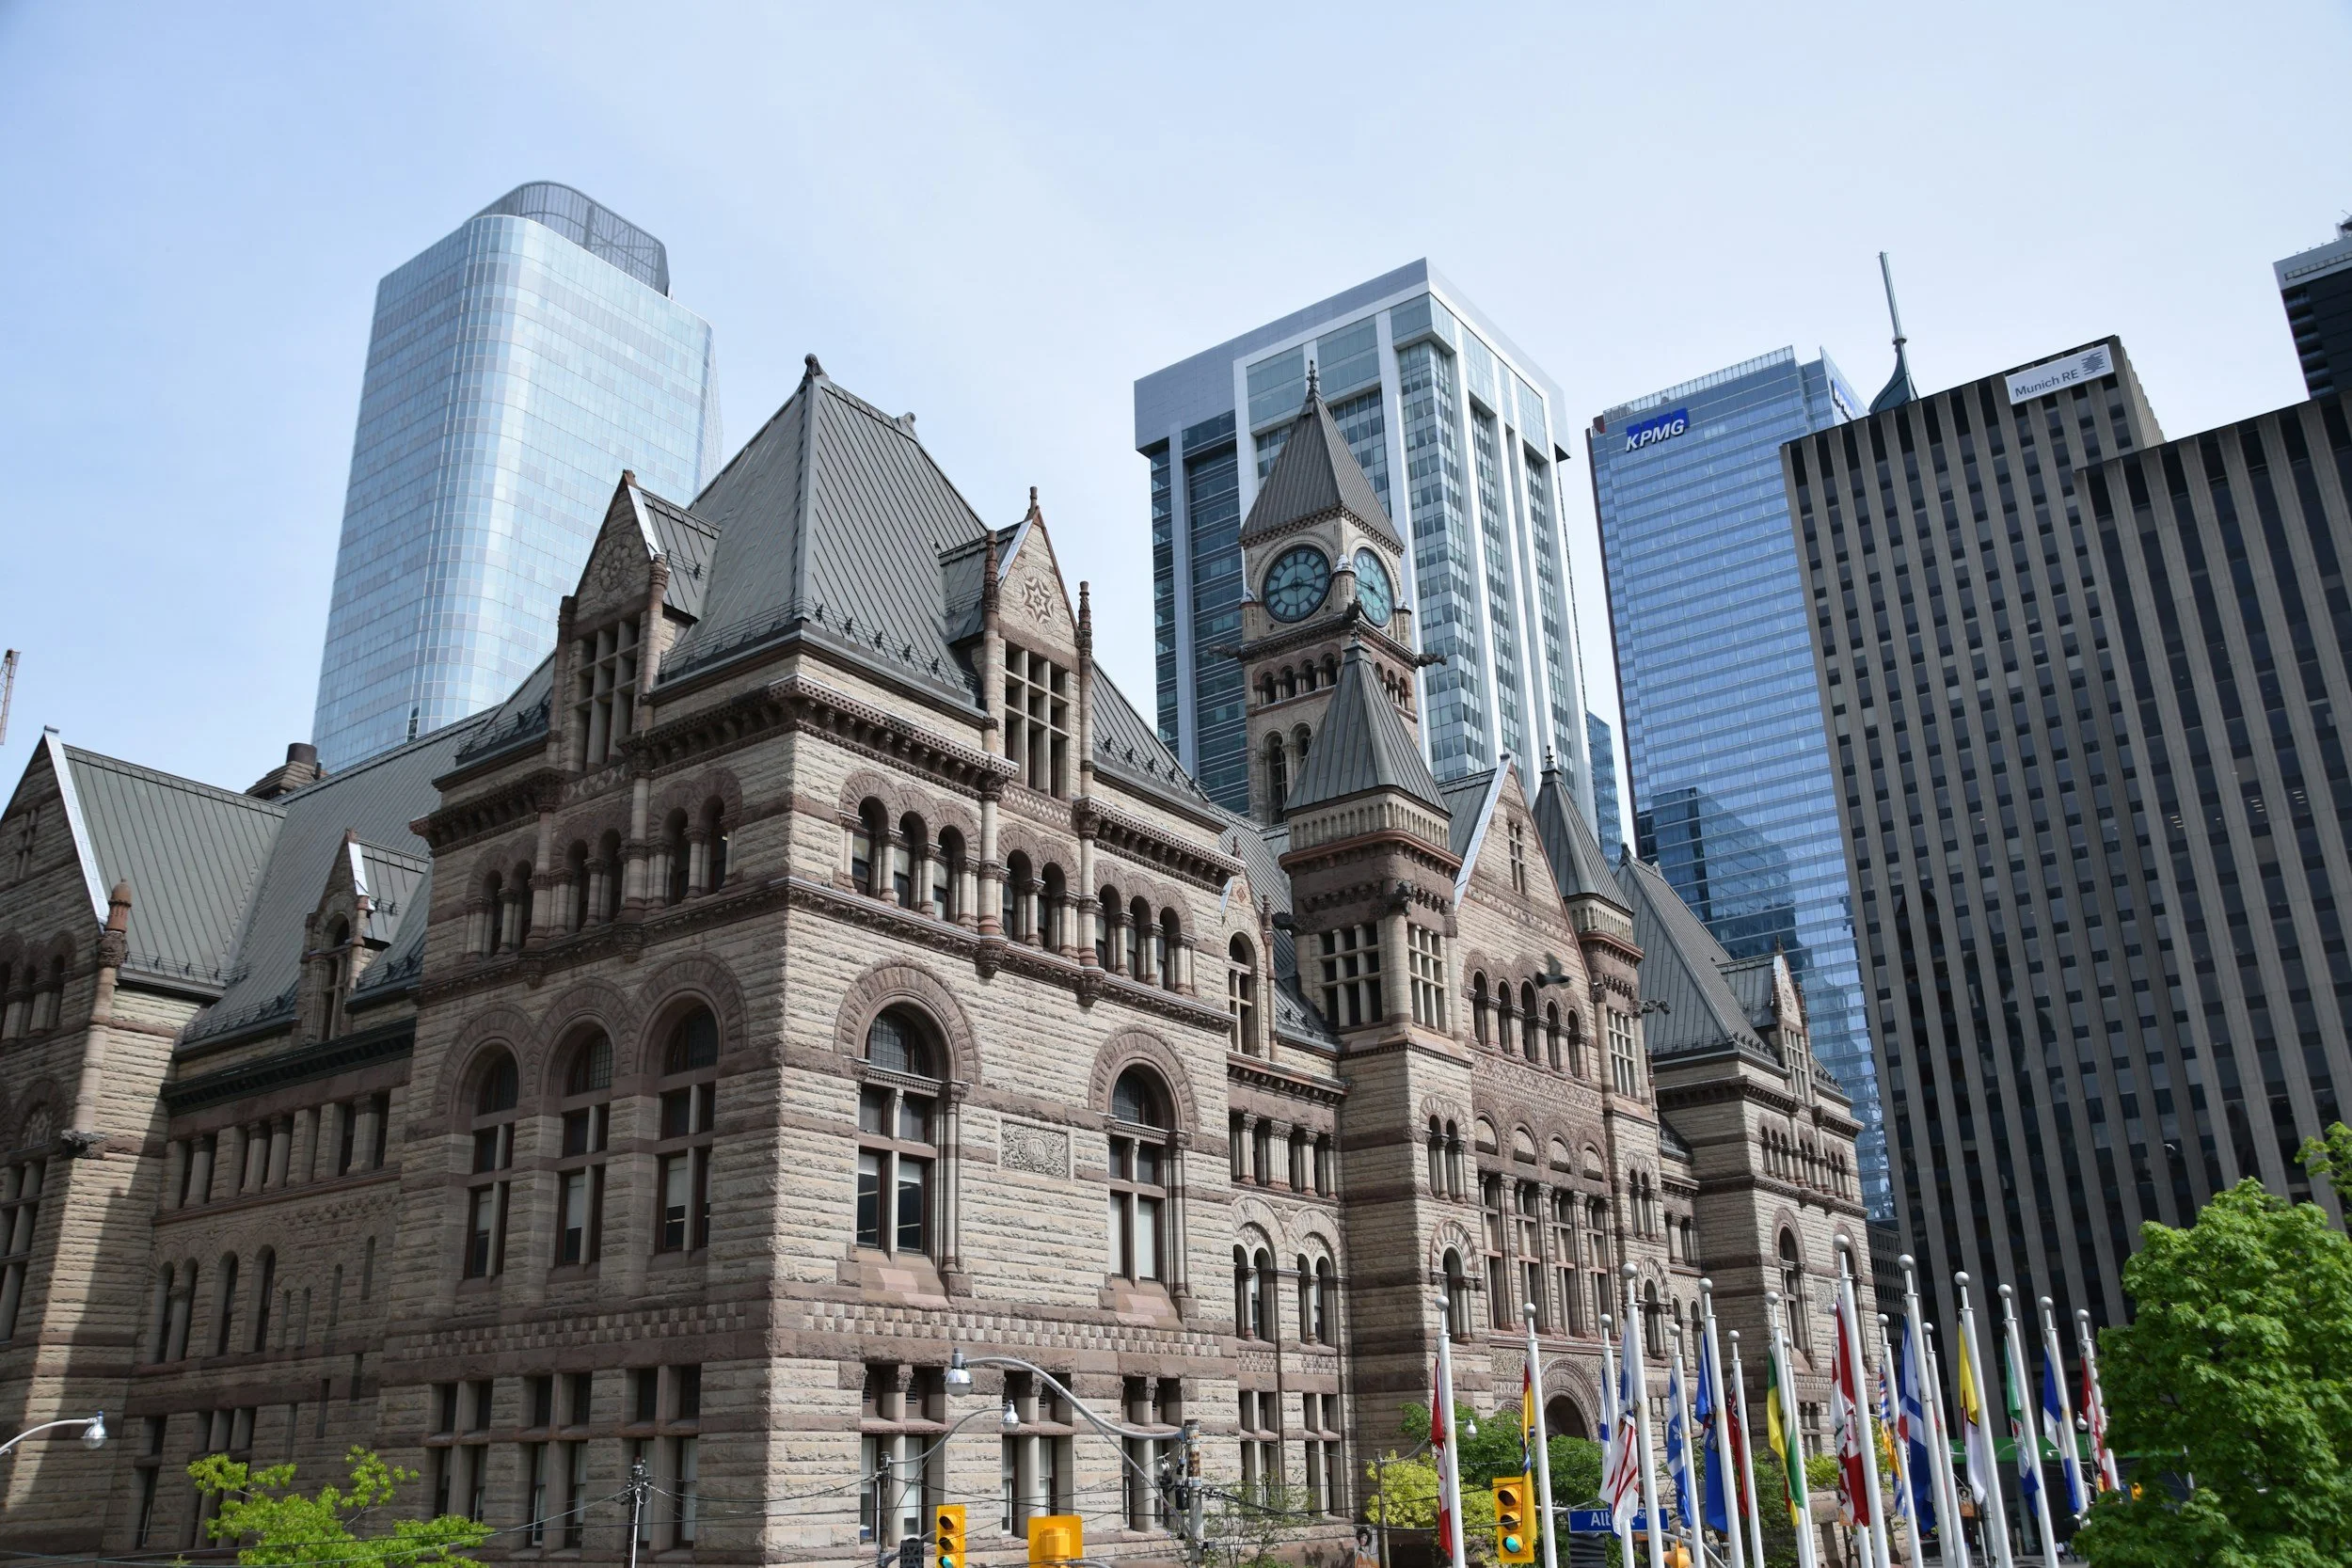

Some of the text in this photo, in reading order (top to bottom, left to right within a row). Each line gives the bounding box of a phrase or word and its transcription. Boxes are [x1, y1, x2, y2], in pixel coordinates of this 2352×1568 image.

[2015, 369, 2079, 397] Munich RE
[1626, 419, 1685, 451] KPMG
[1590, 1511, 1646, 1527] Albt St
